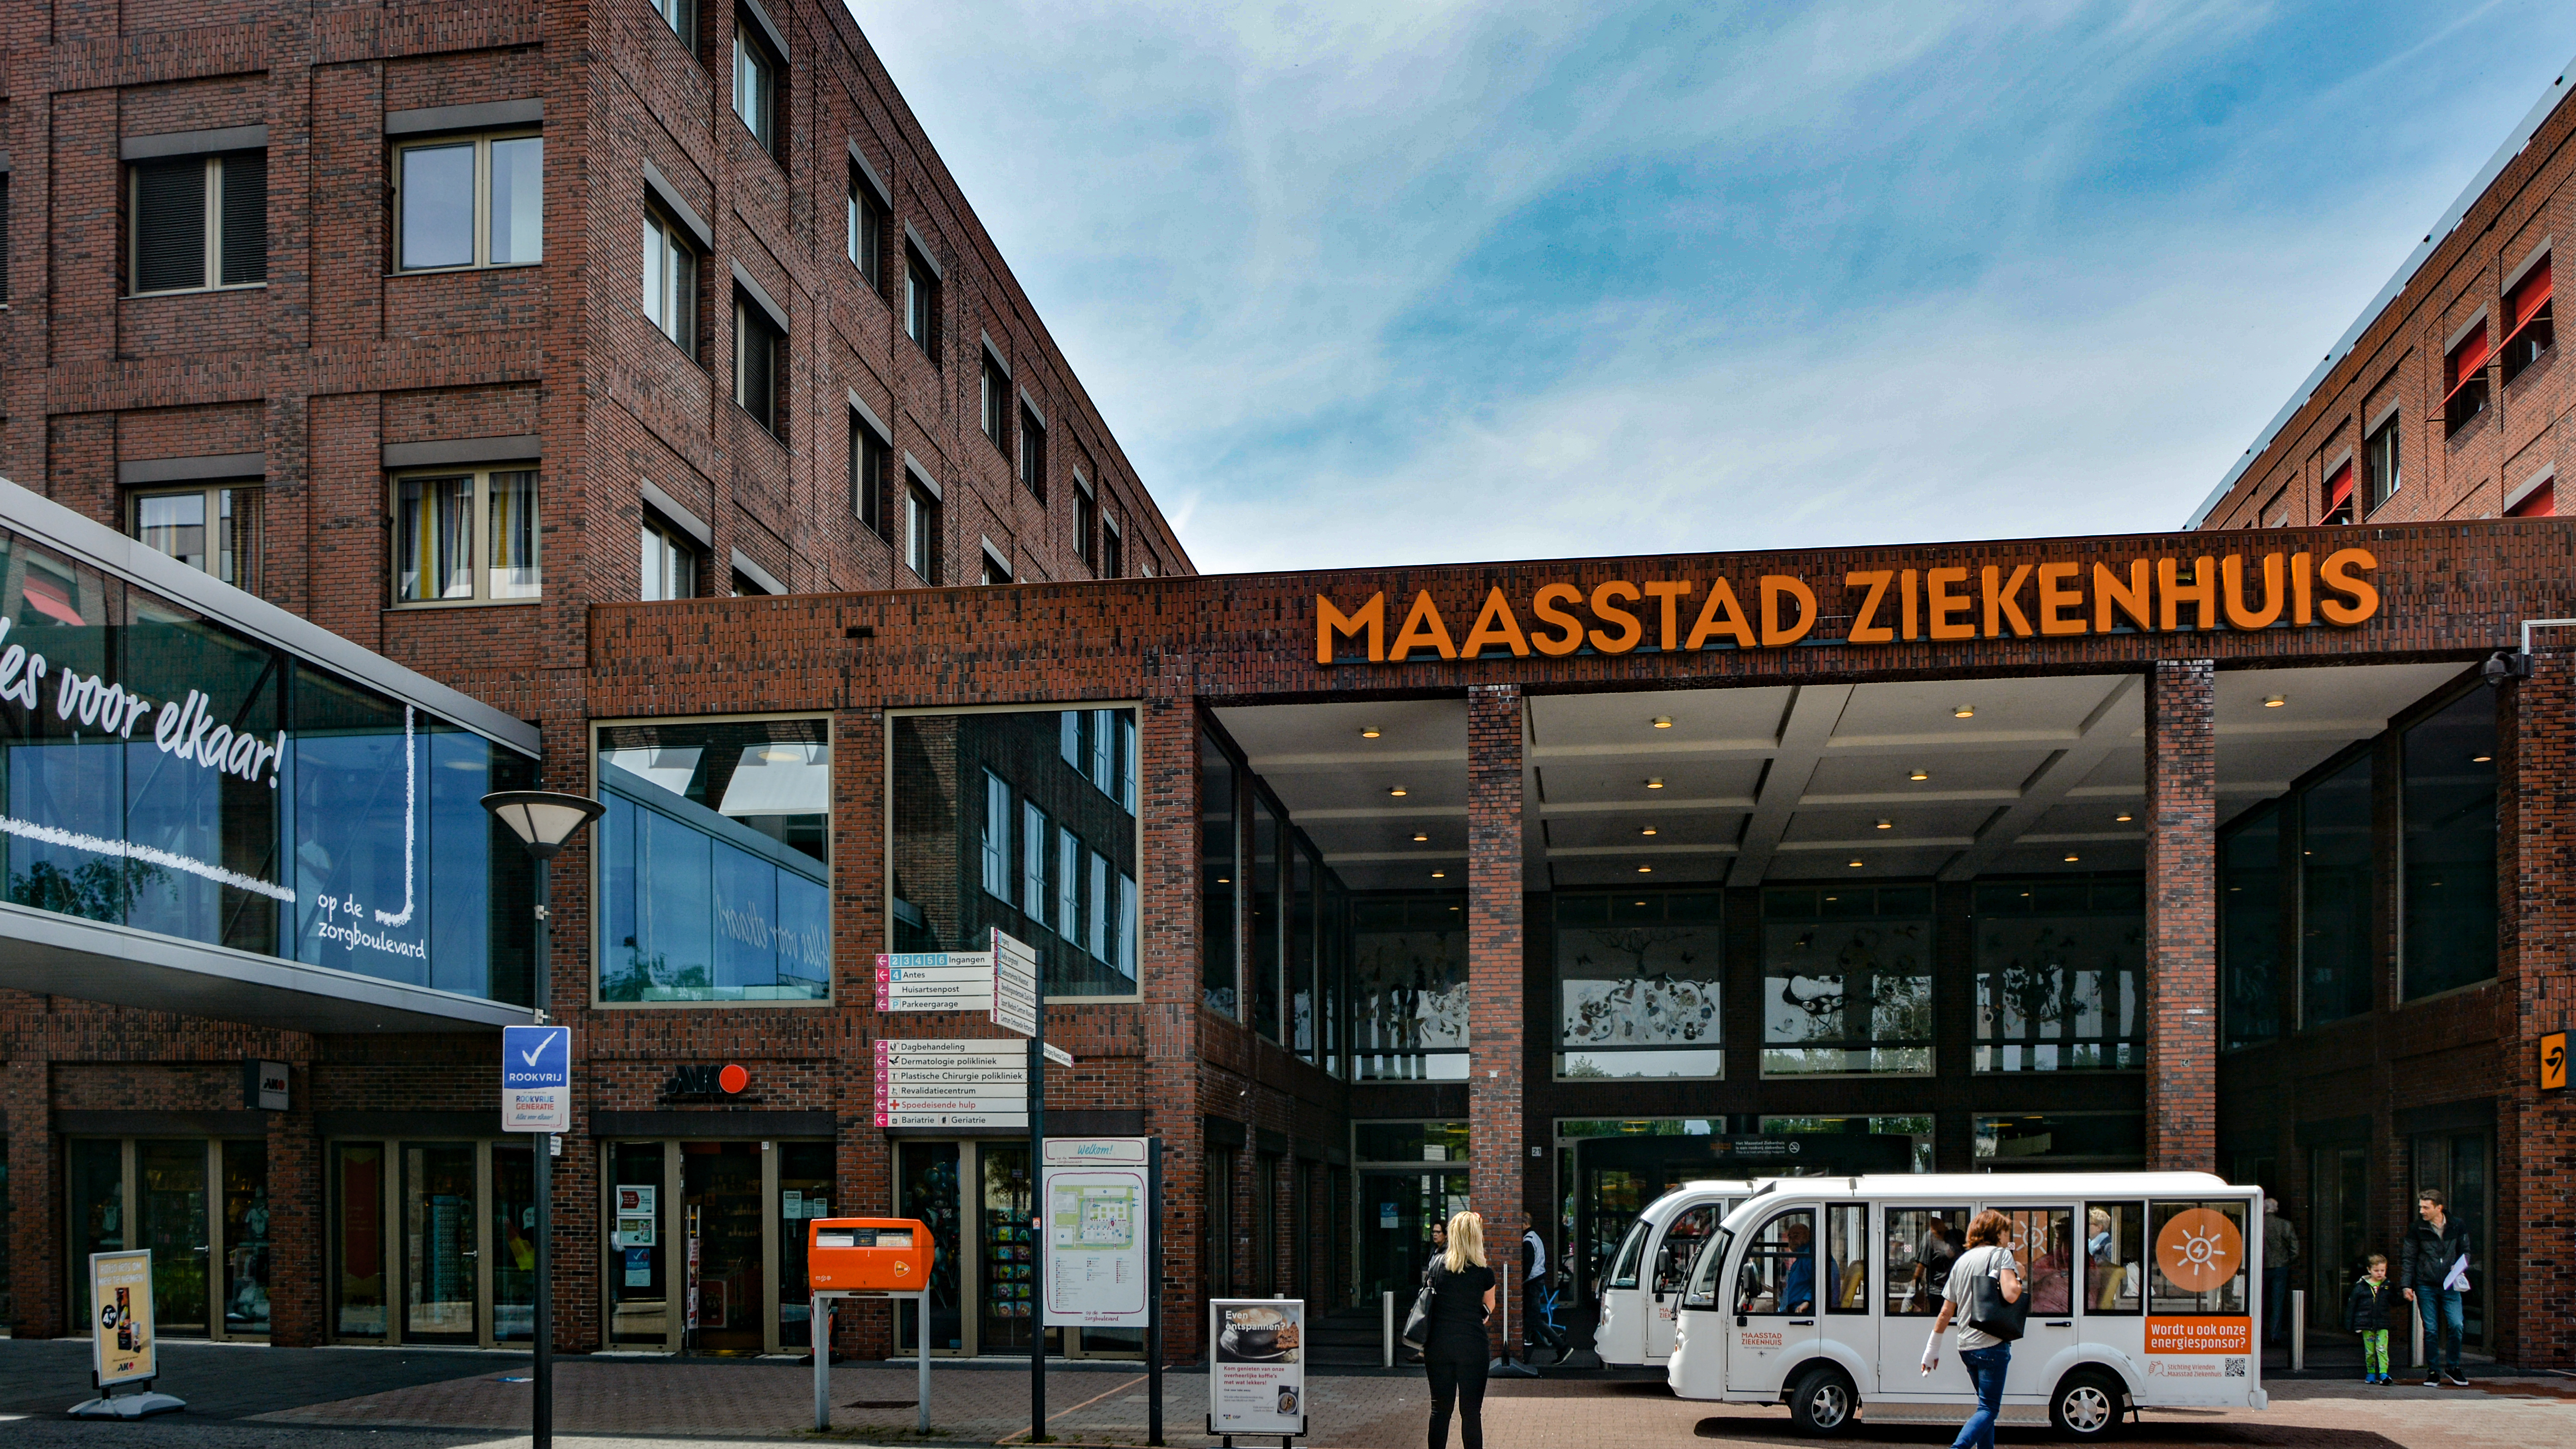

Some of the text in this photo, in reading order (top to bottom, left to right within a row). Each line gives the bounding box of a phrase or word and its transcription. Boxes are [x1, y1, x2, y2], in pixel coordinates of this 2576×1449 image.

[1316, 548, 2379, 664] MAASSTAD ZIEKENHUIS
[57, 667, 150, 739] voor
[156, 689, 286, 789] elkaar!
[318, 893, 363, 922] op de
[318, 921, 426, 959] zorgboulevard
[1001, 1014, 1010, 1024] Centrum
[901, 1043, 965, 1052] Dagbehandeling
[901, 1057, 997, 1066] Dermatologie polikliniek
[510, 1073, 561, 1082] ROOKVRIJ
[665, 1064, 750, 1094] AKO
[942, 1072, 979, 1081] Chirurgie
[982, 1072, 1023, 1081] polikliniek
[902, 1101, 976, 1110] Spoedeisende hulp
[1077, 1144, 1113, 1155] Welkom!
[1225, 1310, 1248, 1319] Even
[1225, 1323, 1286, 1332] ontspannen?
[2151, 1324, 2246, 1335] Wordt u ook onze
[2151, 1337, 2246, 1350] energiesponsor?
